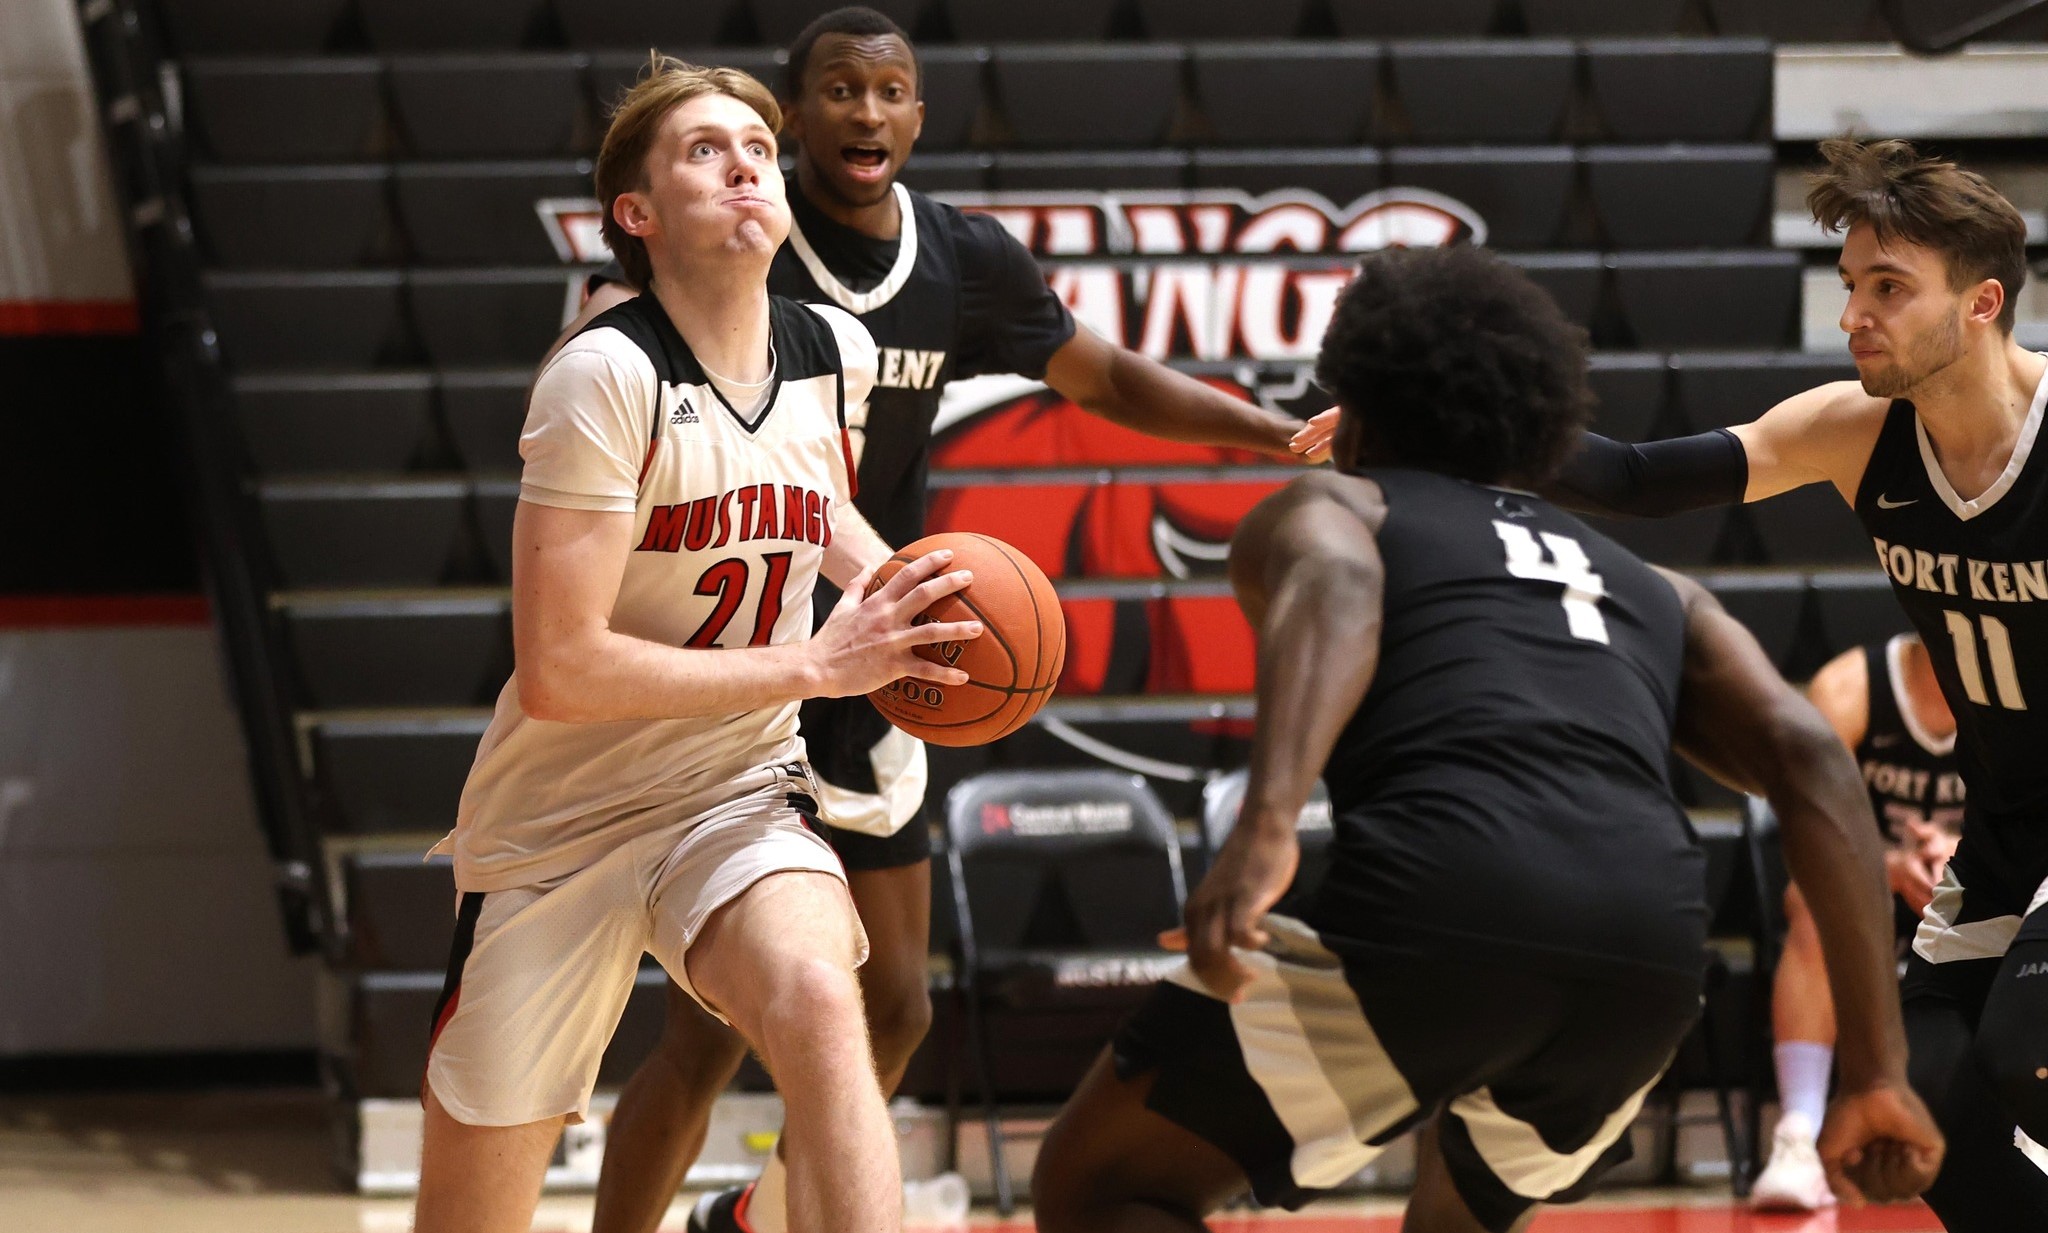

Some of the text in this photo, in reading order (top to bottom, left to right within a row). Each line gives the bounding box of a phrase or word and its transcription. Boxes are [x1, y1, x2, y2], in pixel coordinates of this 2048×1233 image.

[875, 346, 946, 390] ENT
[670, 411, 700, 425] adidas
[633, 483, 832, 553] MUSTANGS
[683, 551, 793, 649] 21
[1491, 519, 1611, 646] 4
[1873, 536, 2048, 603] FORT KEN
[1942, 609, 2028, 711] 11
